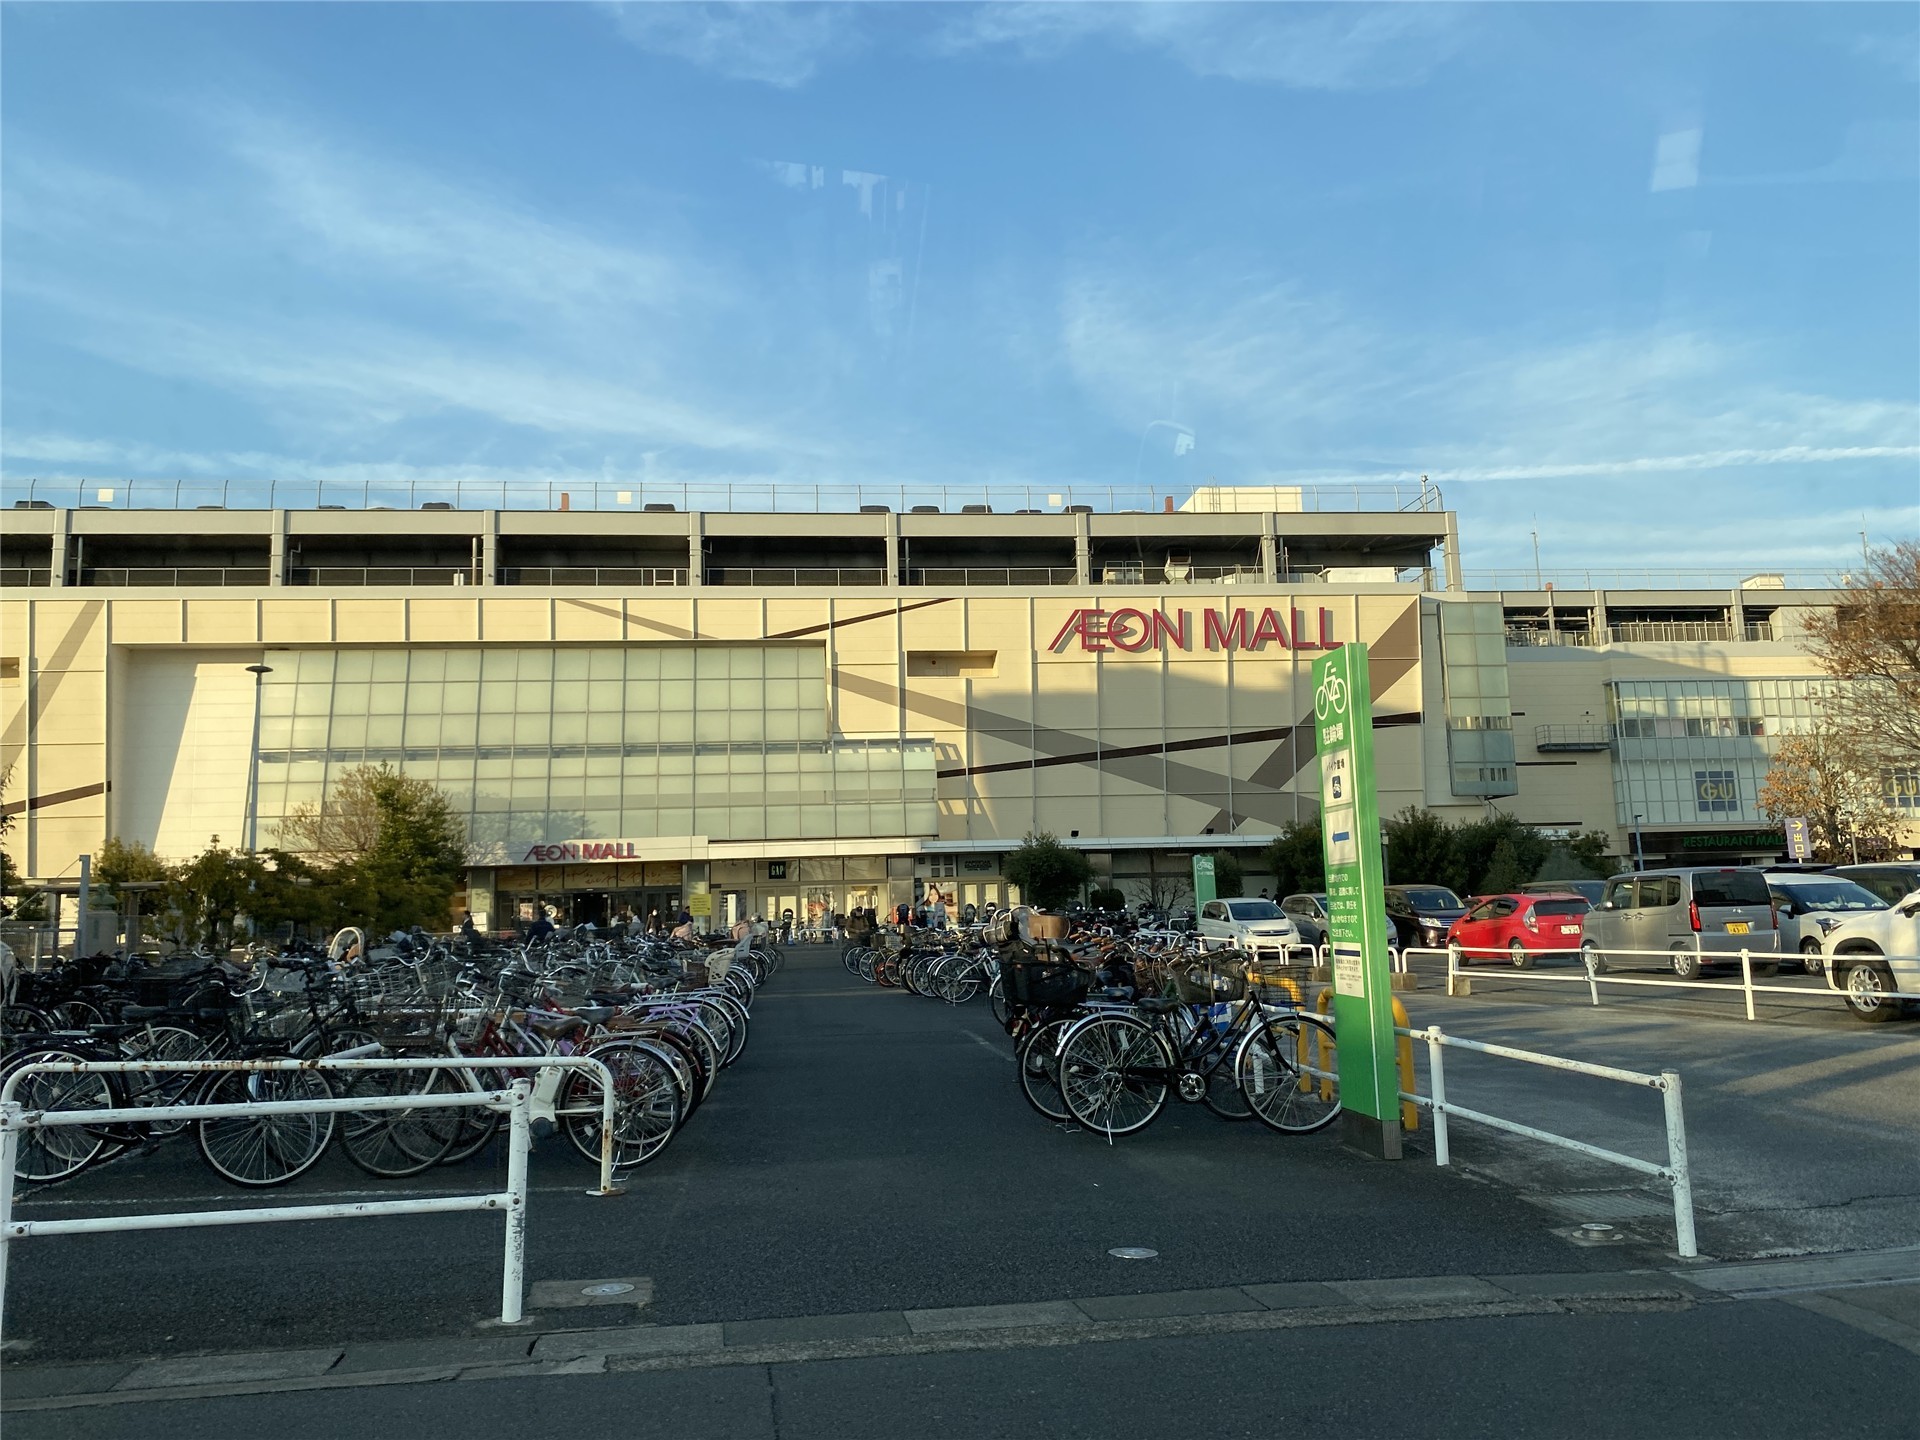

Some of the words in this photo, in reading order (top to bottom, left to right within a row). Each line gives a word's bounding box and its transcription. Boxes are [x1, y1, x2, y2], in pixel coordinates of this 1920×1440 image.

[1203, 607, 1344, 649] MALL
[1700, 782, 1733, 800] GU
[1886, 779, 1917, 796] GU
[1683, 835, 1755, 848] RESTAURANT
[1756, 834, 1786, 845] MALL
[1793, 833, 1804, 853] 出口
[582, 842, 642, 860] MALL
[771, 865, 784, 875] GAP
